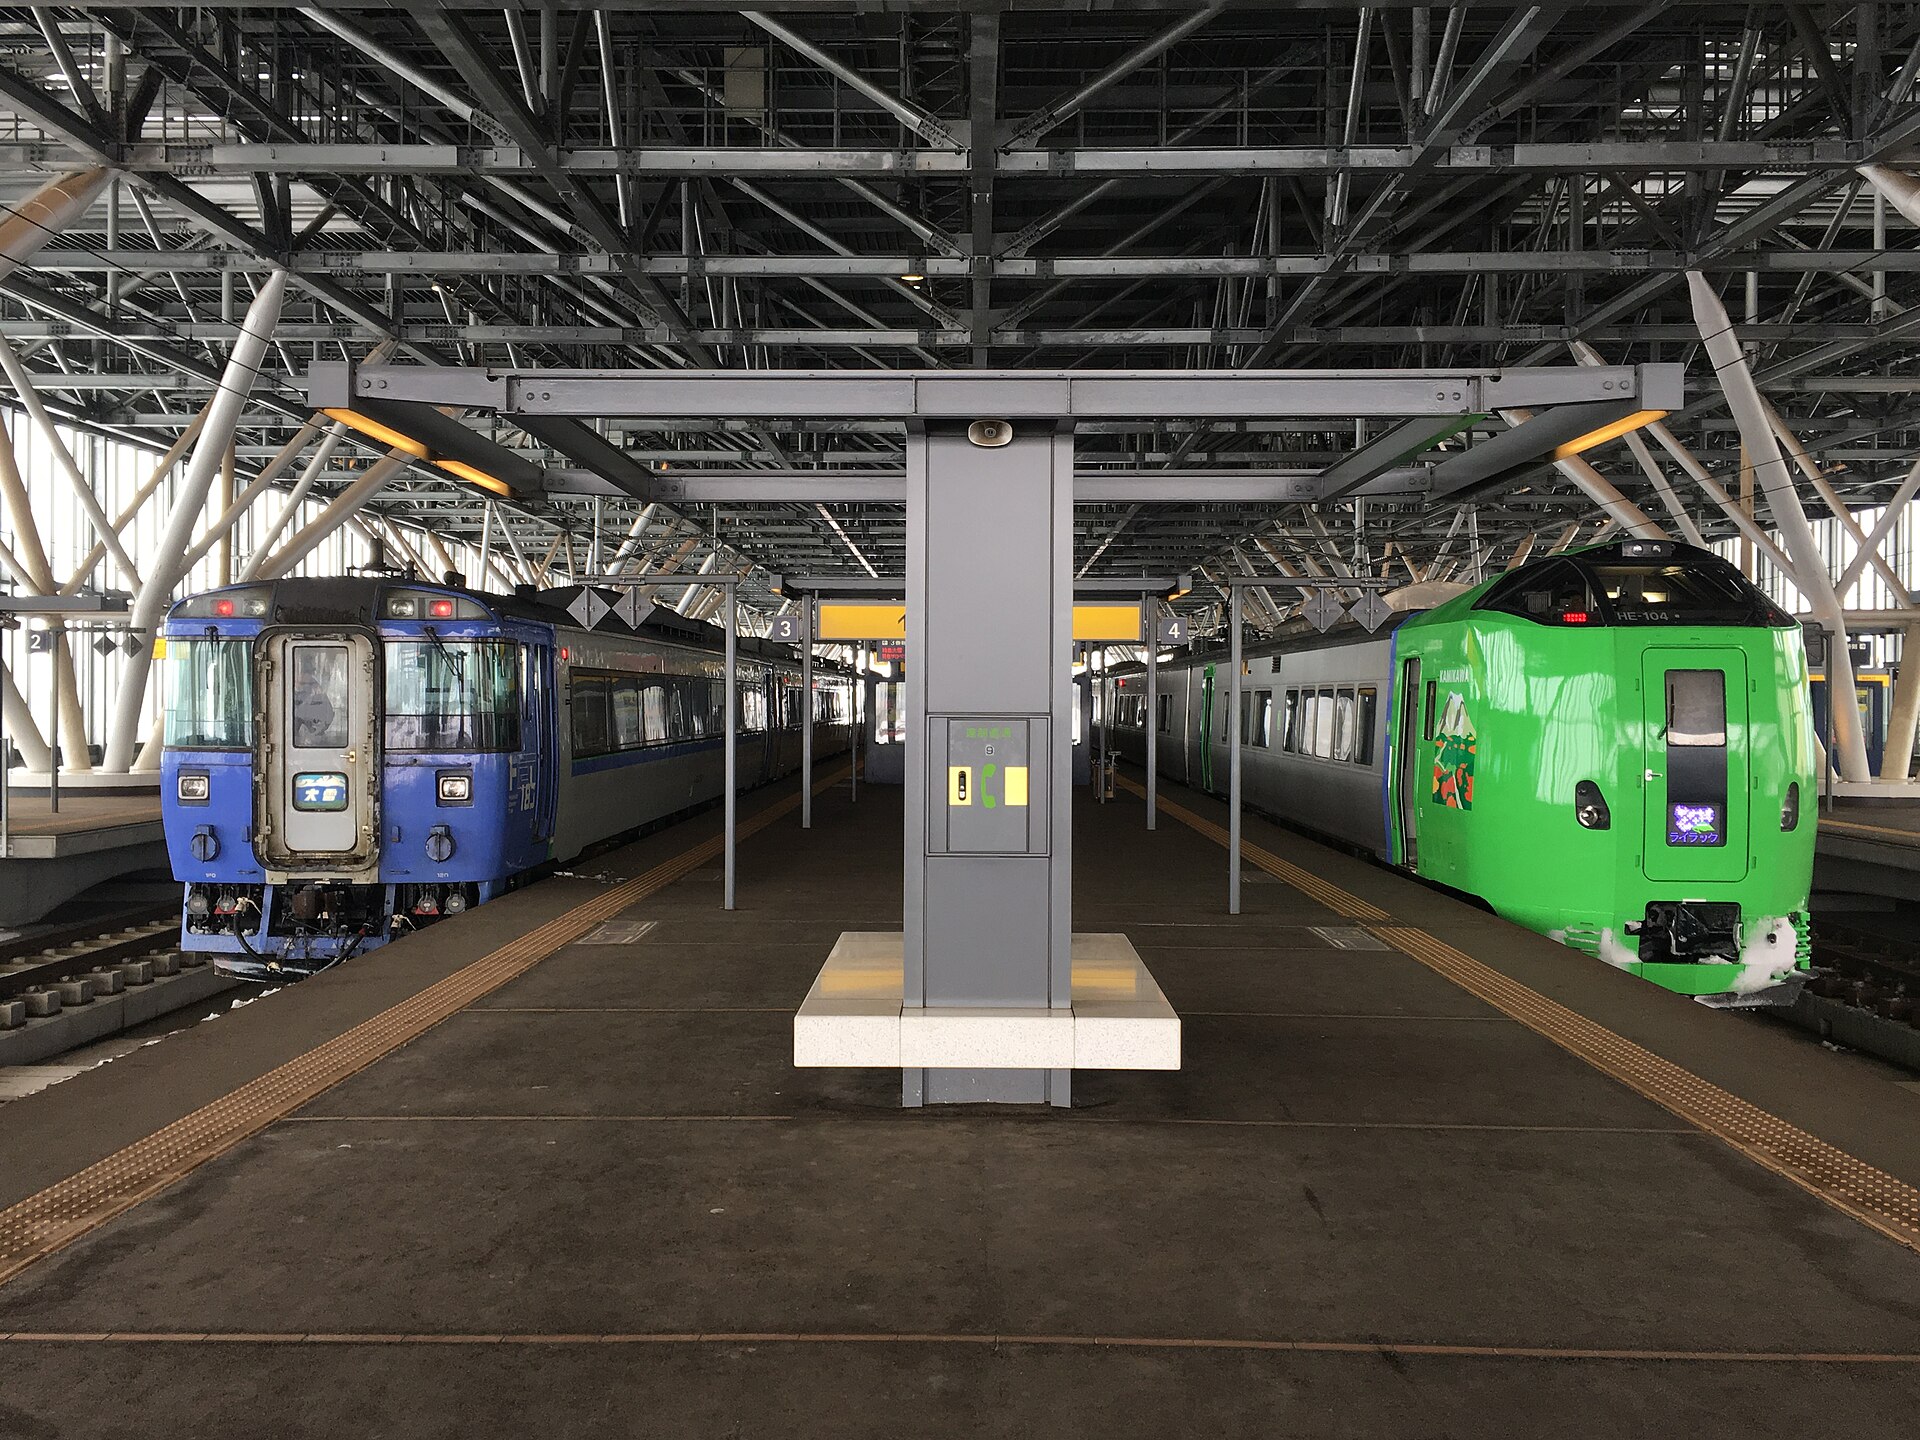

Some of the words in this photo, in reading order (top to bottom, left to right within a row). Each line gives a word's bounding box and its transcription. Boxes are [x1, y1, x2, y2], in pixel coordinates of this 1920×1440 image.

[1616, 611, 1669, 621] HE-104
[780, 621, 791, 637] 3
[1168, 622, 1181, 639] 4
[30, 634, 41, 649] 2
[985, 744, 995, 756] 9
[1669, 832, 1719, 843] ライラック
